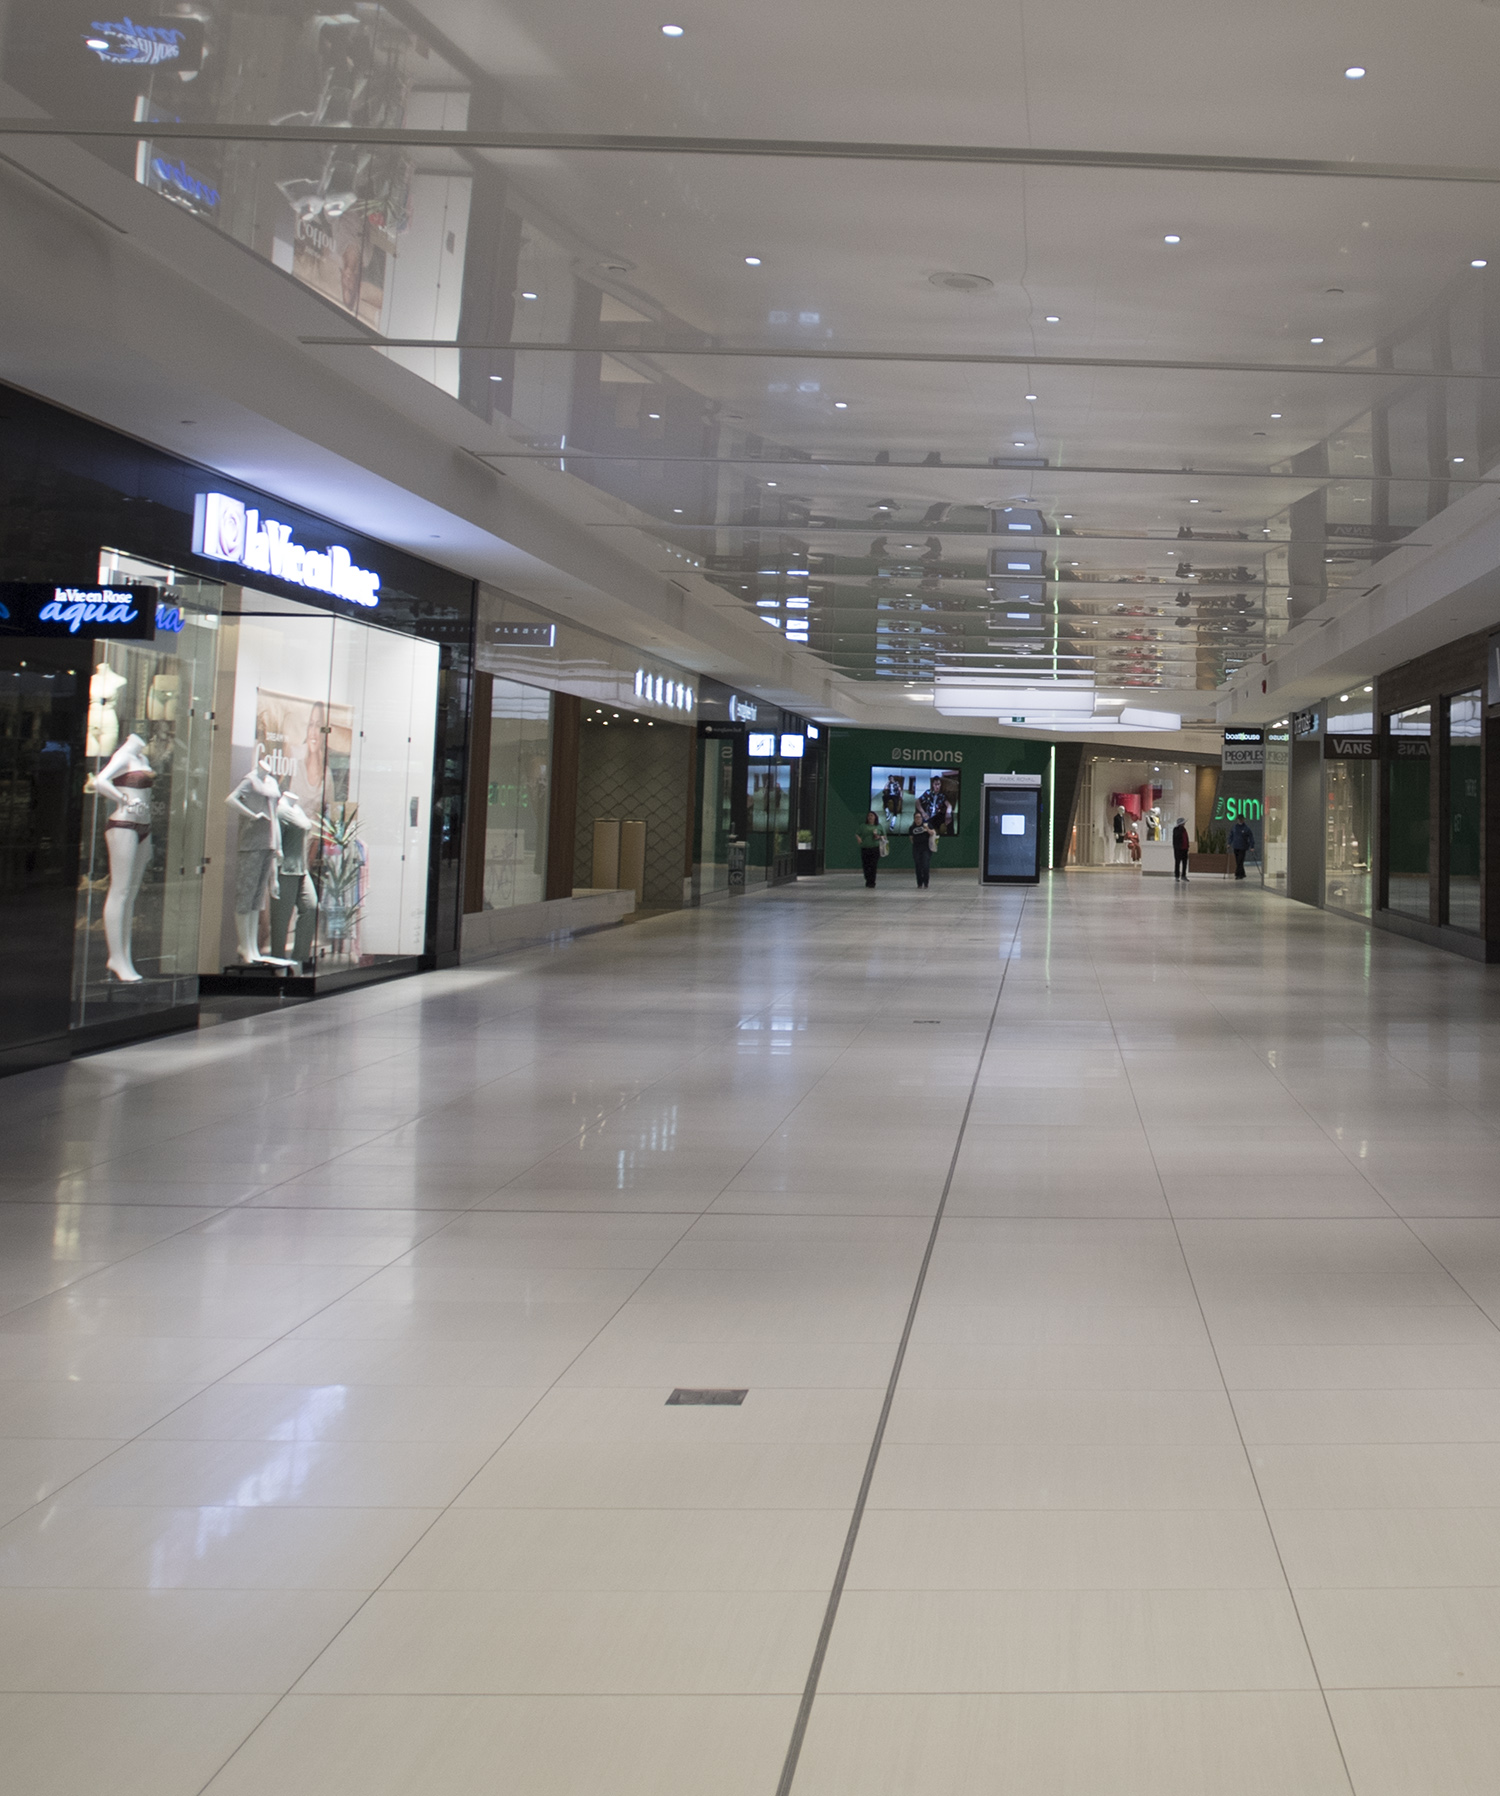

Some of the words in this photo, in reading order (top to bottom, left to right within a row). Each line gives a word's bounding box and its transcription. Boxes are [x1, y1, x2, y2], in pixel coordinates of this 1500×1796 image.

[39, 602, 138, 633] aqua
[1333, 739, 1372, 754] VANS
[902, 748, 963, 763] simons
